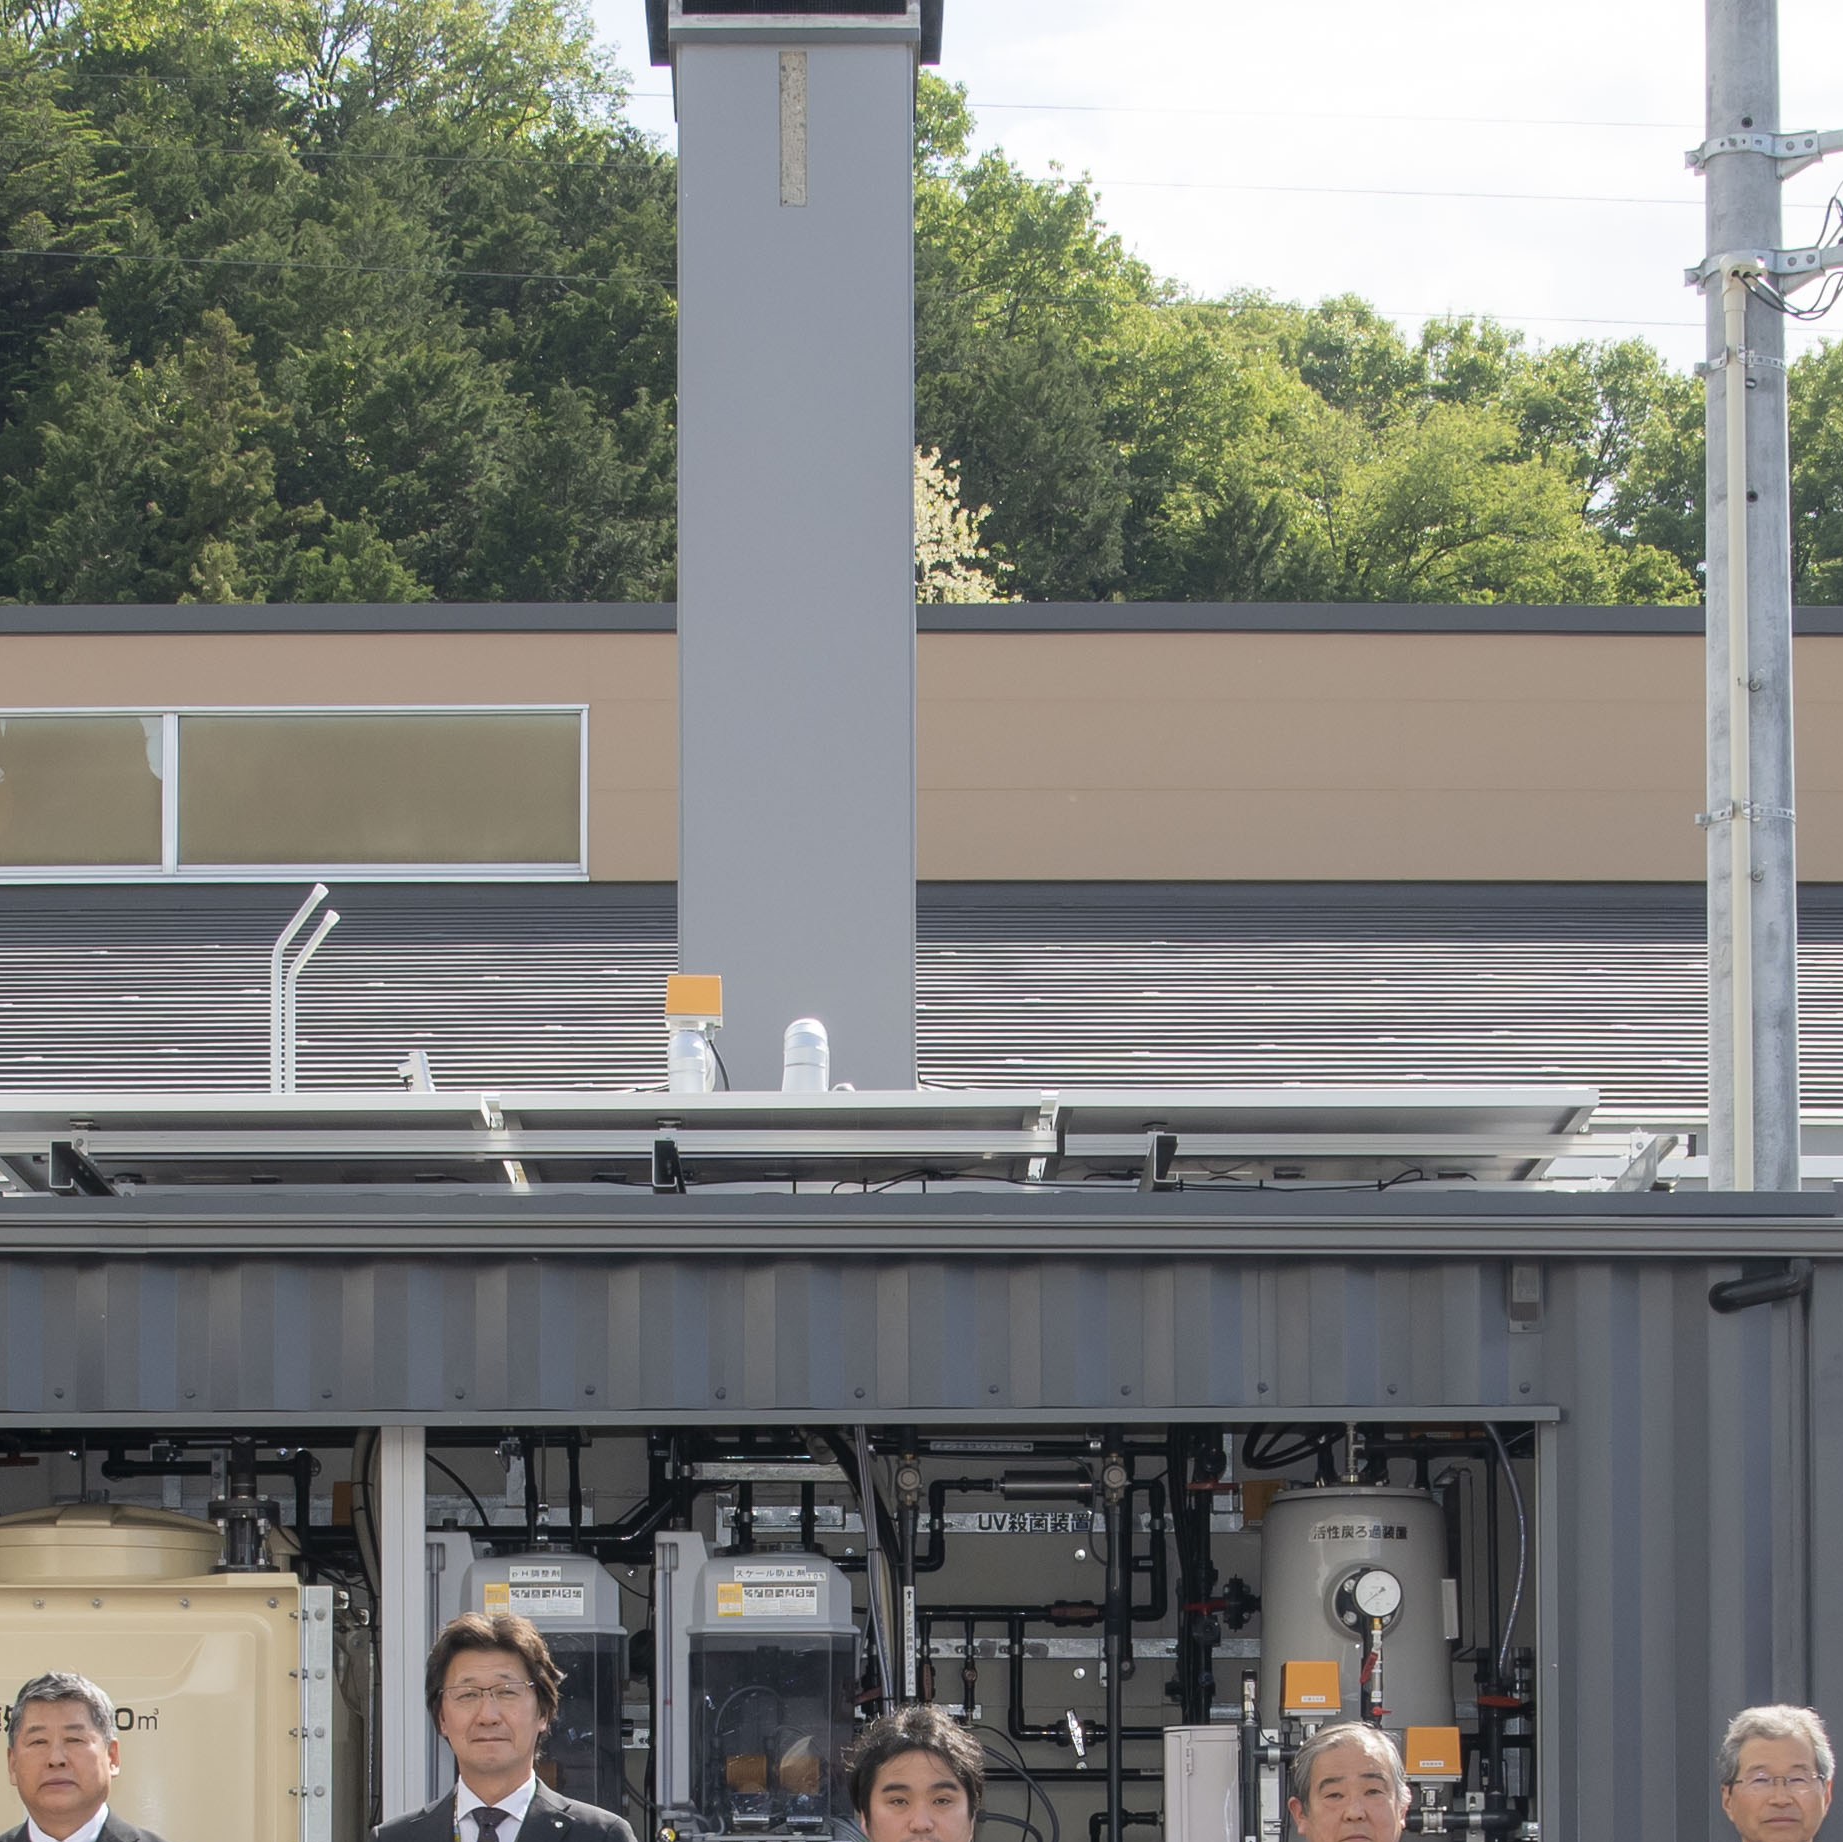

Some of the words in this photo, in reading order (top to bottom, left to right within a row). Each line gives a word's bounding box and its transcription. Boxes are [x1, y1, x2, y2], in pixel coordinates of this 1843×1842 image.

[978, 1512, 1092, 1533] UV殺菌装置
[1313, 1524, 1408, 1540] 活性炭ろ過装置
